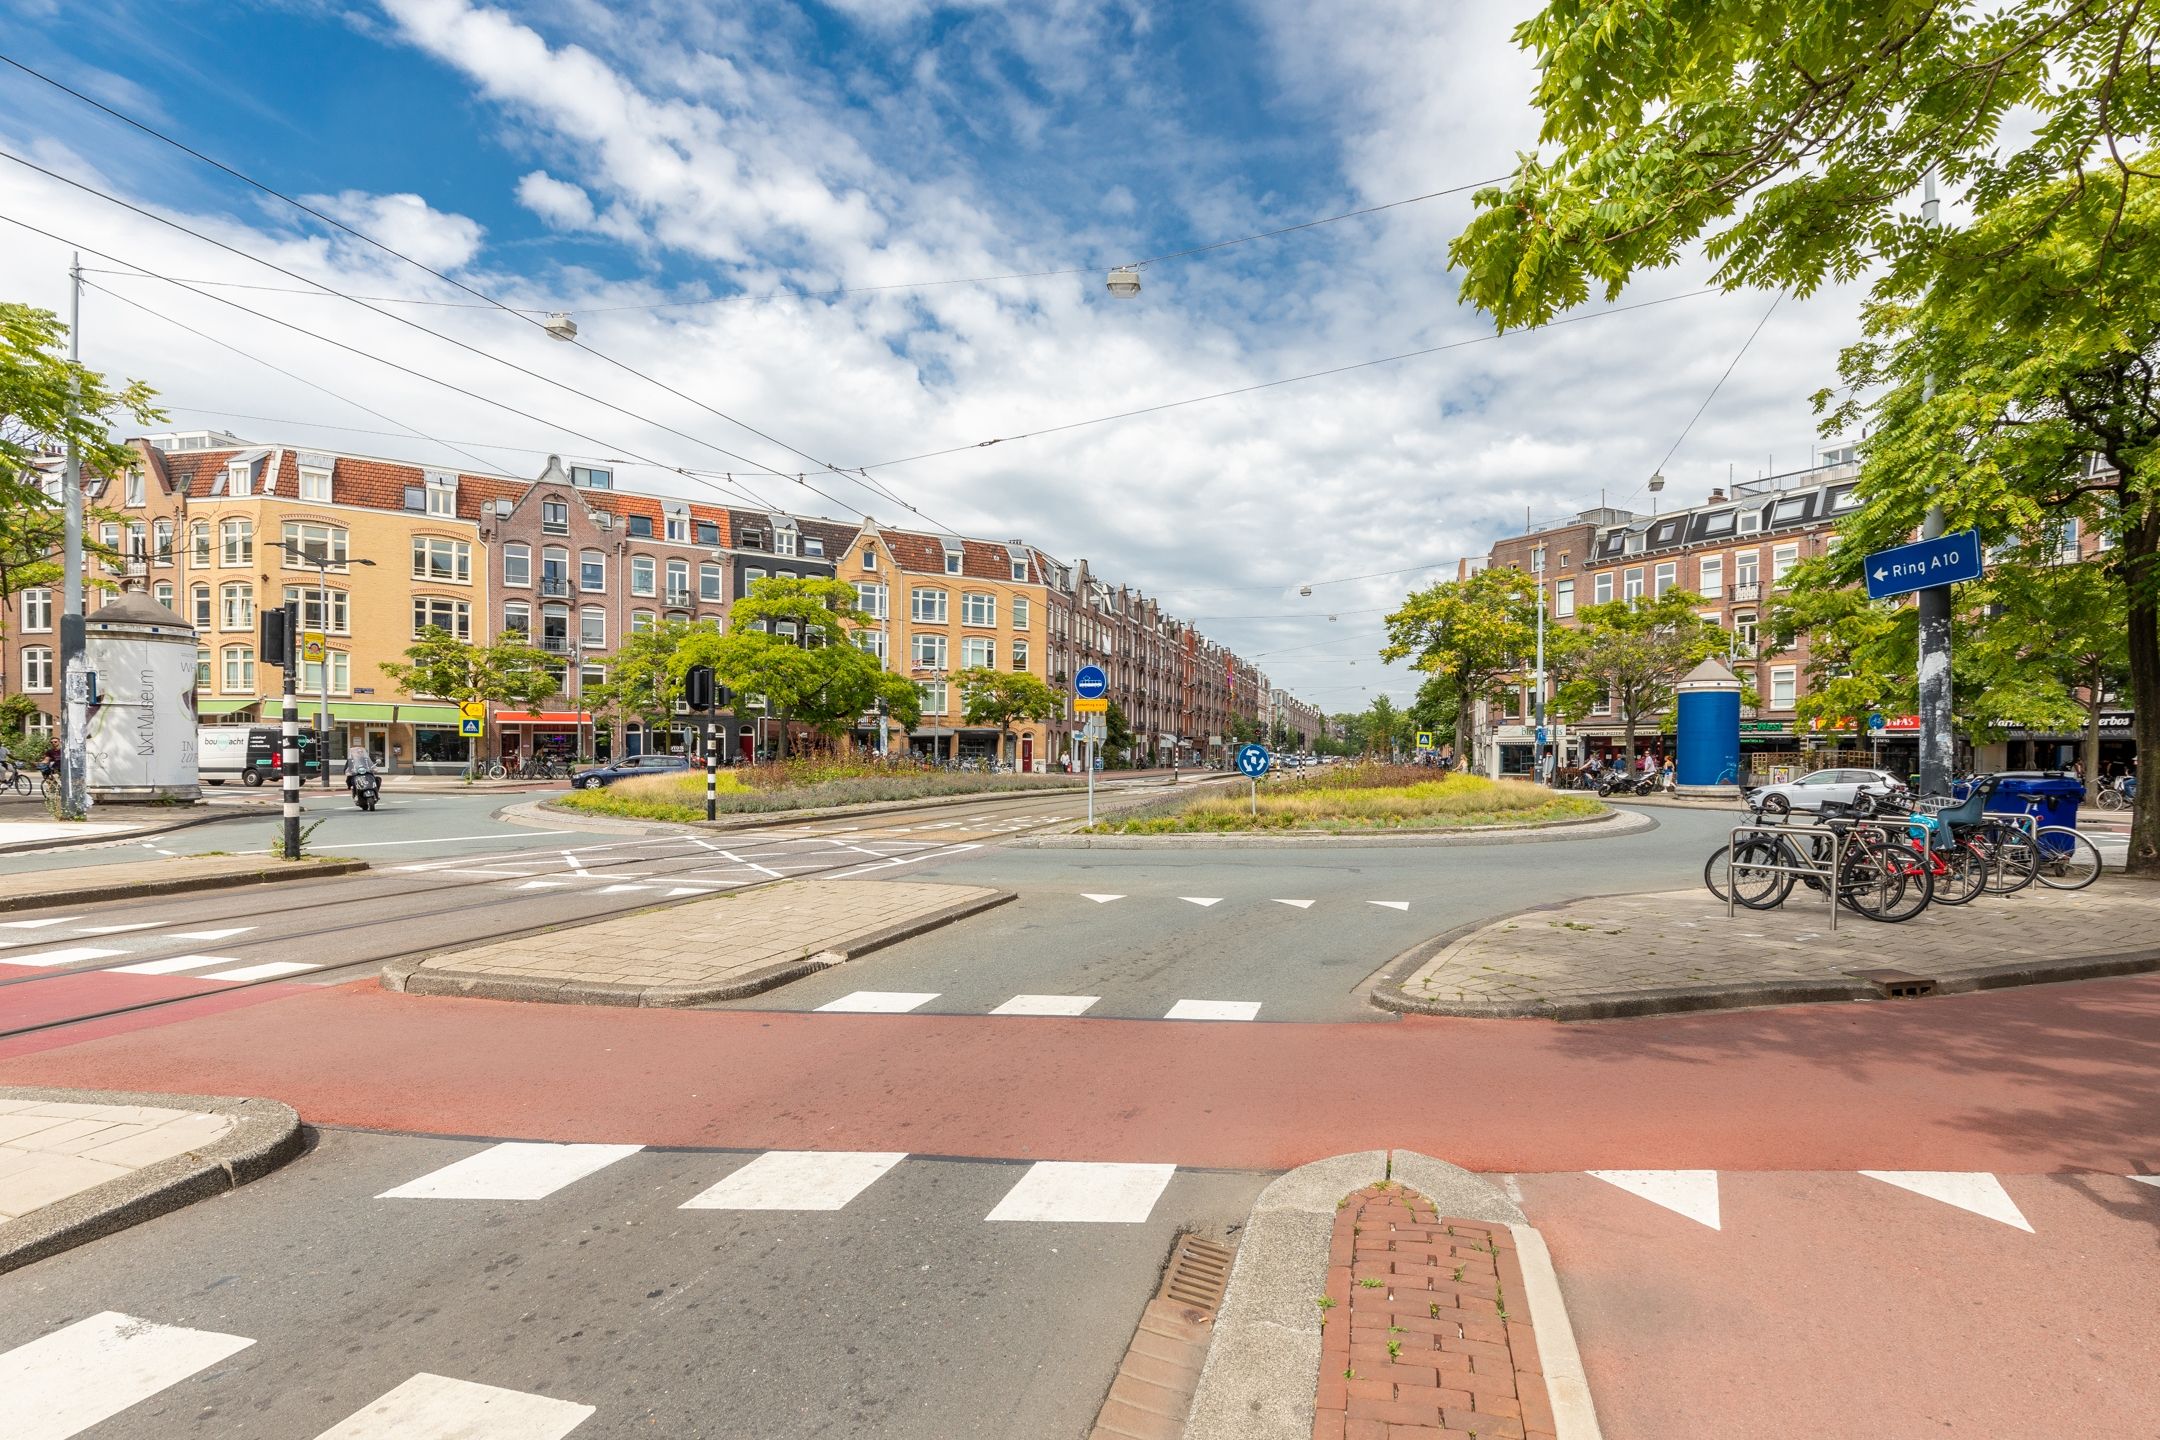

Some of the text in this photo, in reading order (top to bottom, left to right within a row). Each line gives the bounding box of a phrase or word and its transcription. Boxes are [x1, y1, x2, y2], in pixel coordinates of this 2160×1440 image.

[1893, 551, 1959, 578] Ring A10
[137, 669, 154, 756] Nxt Museum
